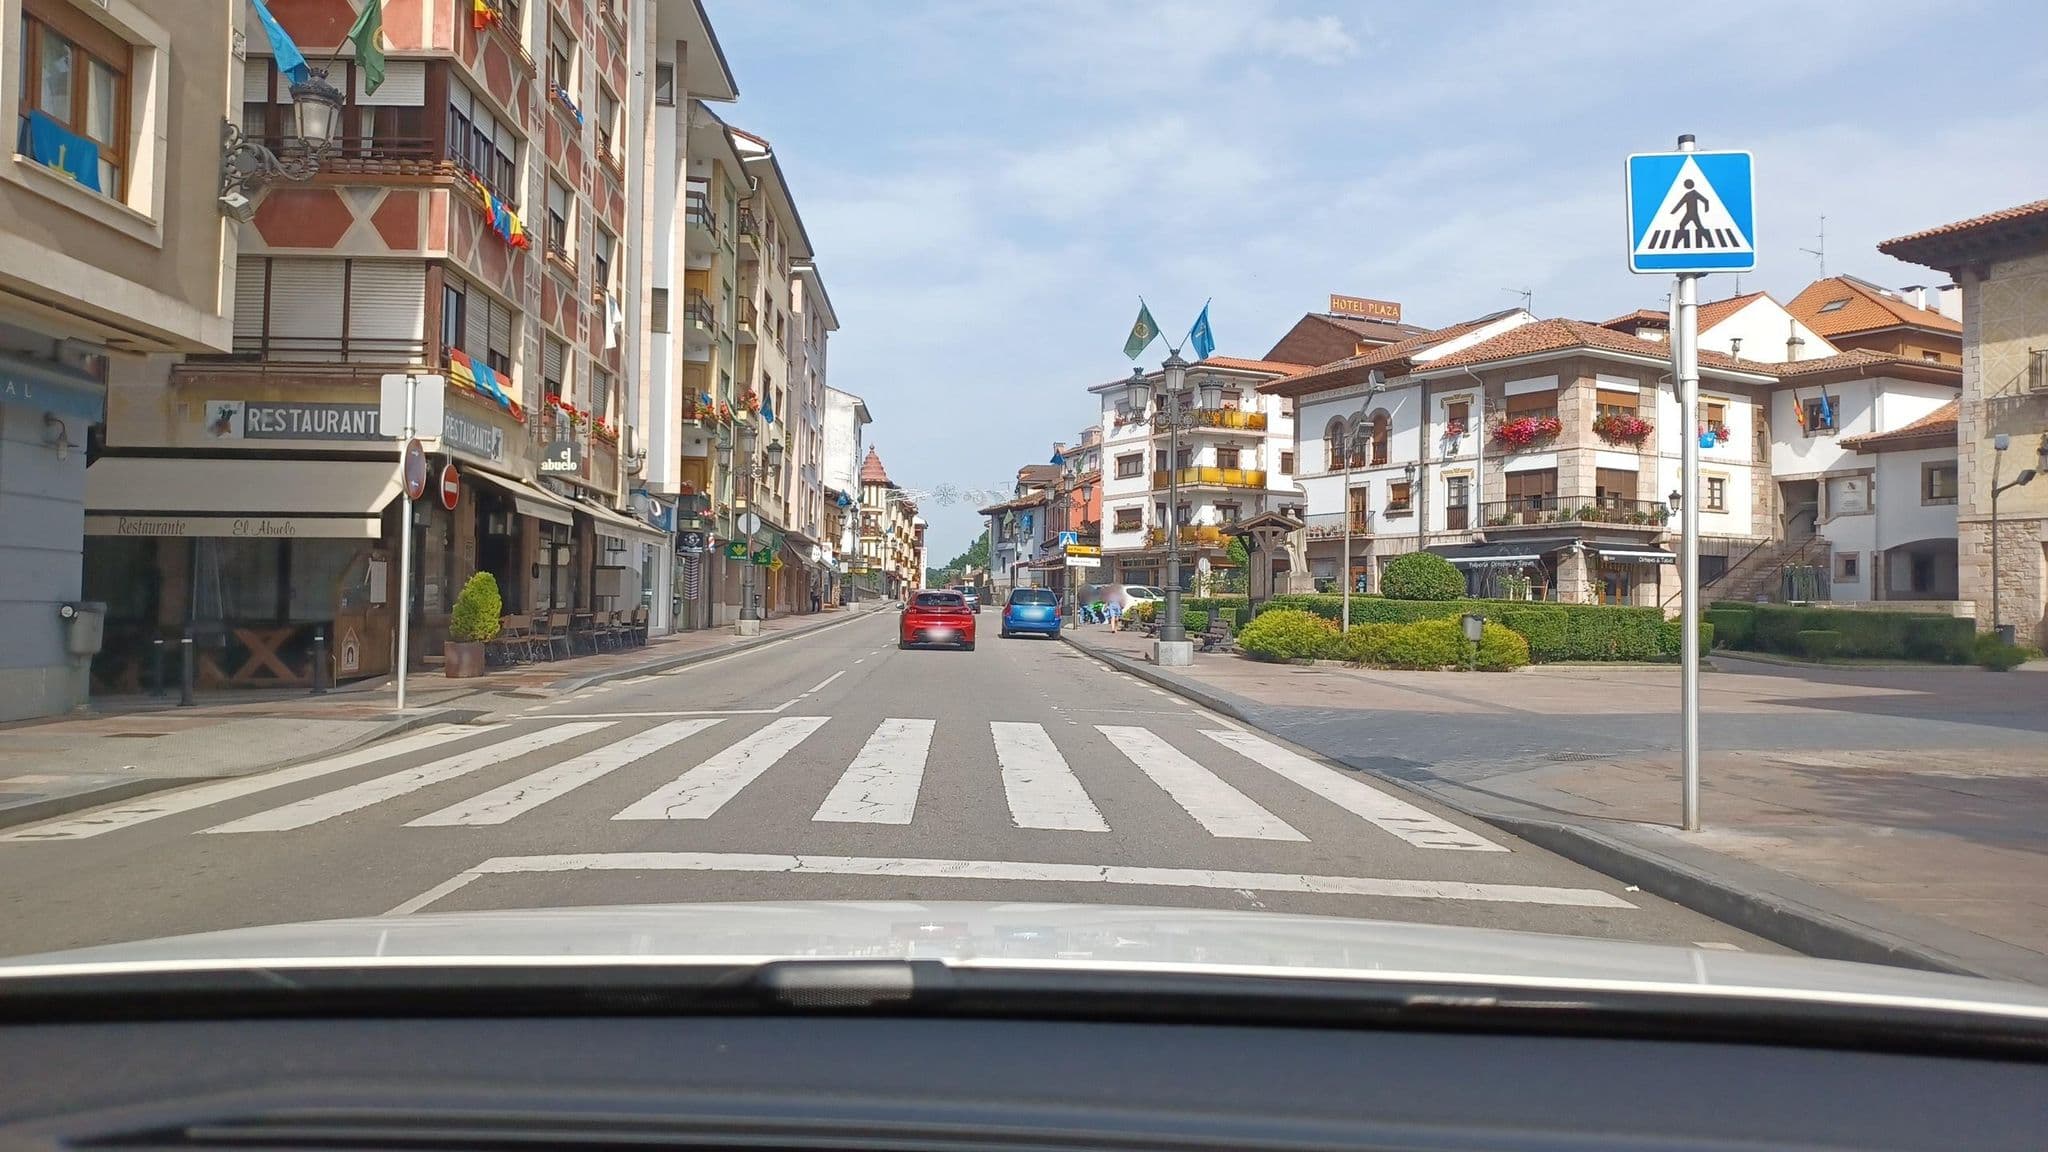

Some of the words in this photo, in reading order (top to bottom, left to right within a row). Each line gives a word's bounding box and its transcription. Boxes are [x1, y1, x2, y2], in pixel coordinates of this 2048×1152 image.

[1332, 298, 1365, 312] HOTEL
[1368, 303, 1399, 317] PLAZA
[247, 408, 379, 435] RESTAURANT
[445, 415, 491, 454] RESTAURANTE
[541, 458, 577, 471] abuelo
[118, 517, 186, 535] Restaurante
[232, 520, 249, 536] El
[251, 521, 296, 537] Abuelo
